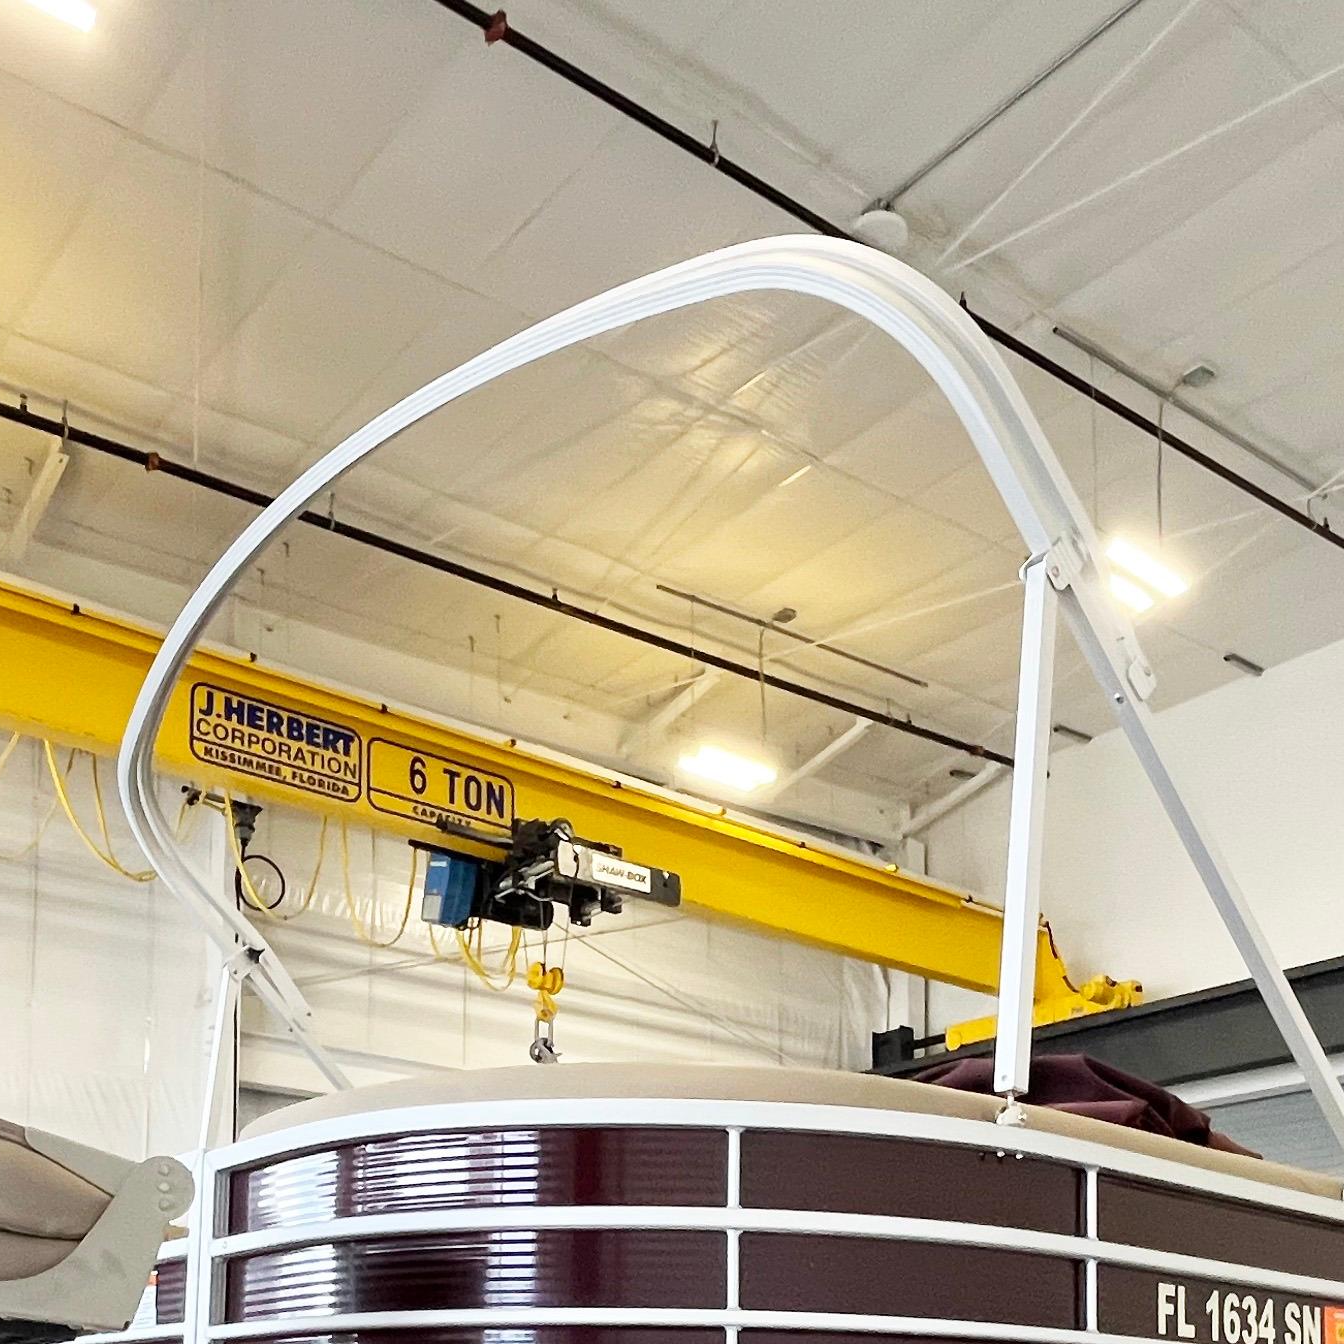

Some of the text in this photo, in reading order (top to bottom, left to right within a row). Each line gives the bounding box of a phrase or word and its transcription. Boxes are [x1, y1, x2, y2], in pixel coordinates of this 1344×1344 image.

[196, 718, 357, 780] CORPORATION
[198, 690, 356, 758] J.HERBERT
[291, 770, 350, 797] FLORIDA
[409, 755, 505, 820] 6 TON
[1157, 1282, 1196, 1339] FL
